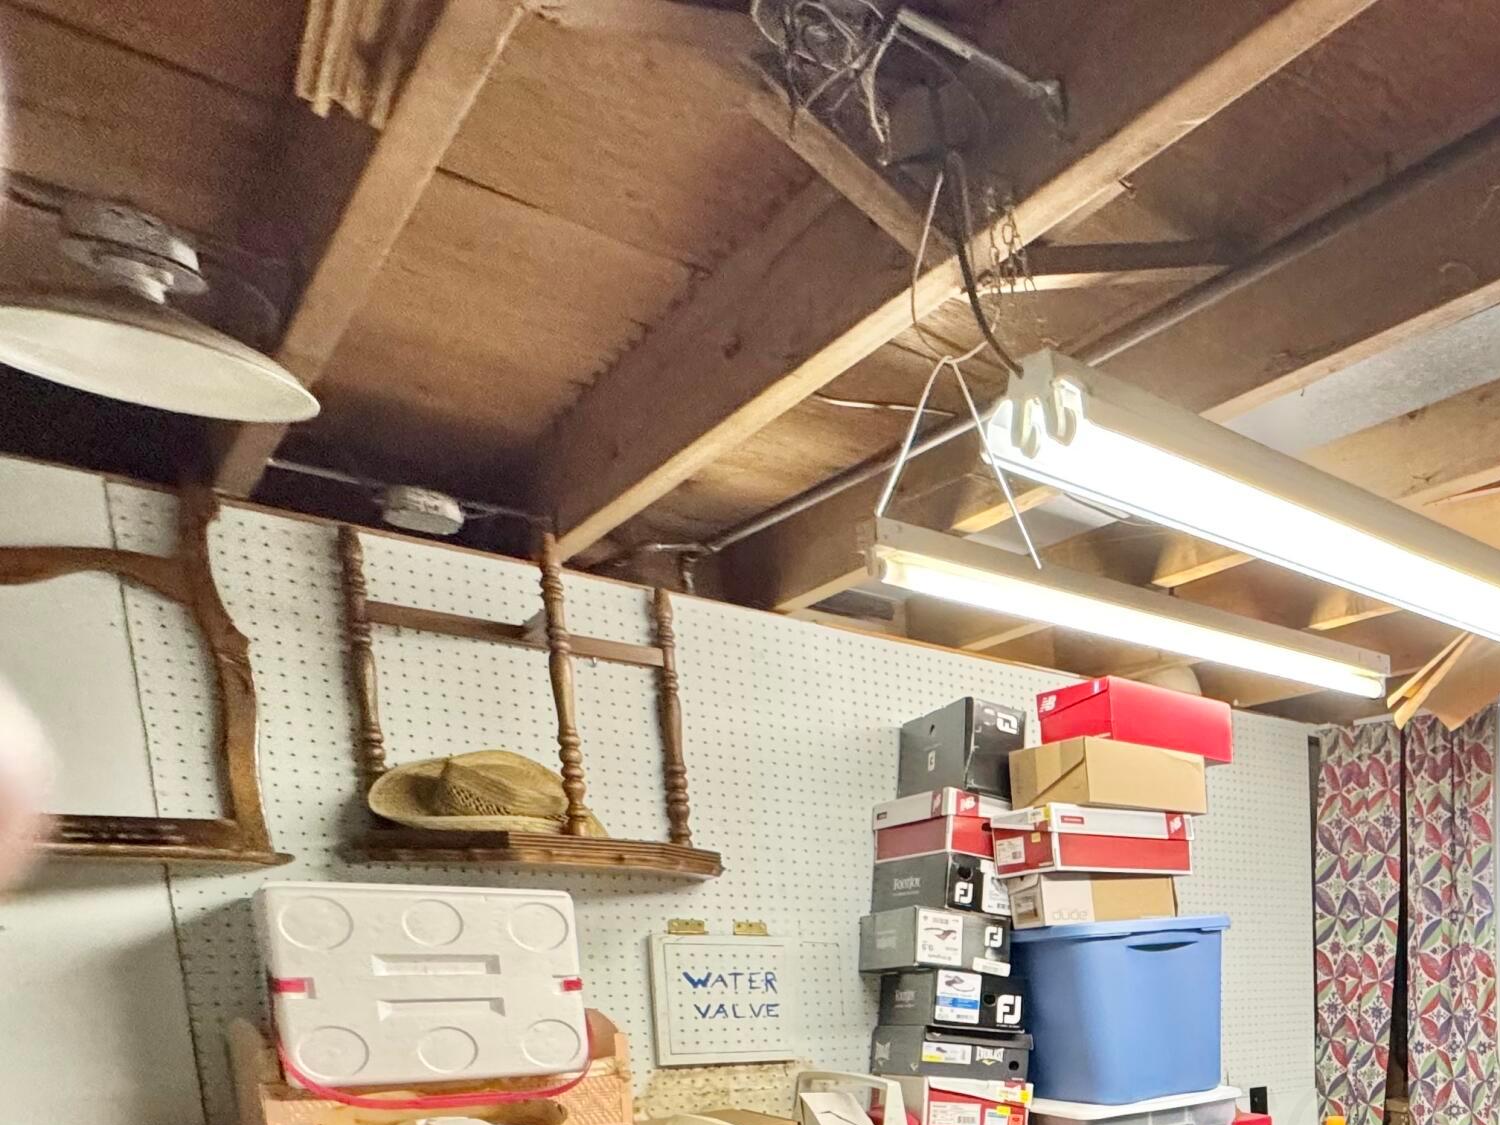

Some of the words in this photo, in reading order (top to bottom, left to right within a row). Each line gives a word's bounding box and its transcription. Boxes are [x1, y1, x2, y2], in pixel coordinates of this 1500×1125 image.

[682, 971, 778, 995] WATER
[693, 1003, 781, 1019] VALVE
[996, 994, 1022, 1025] FJ
